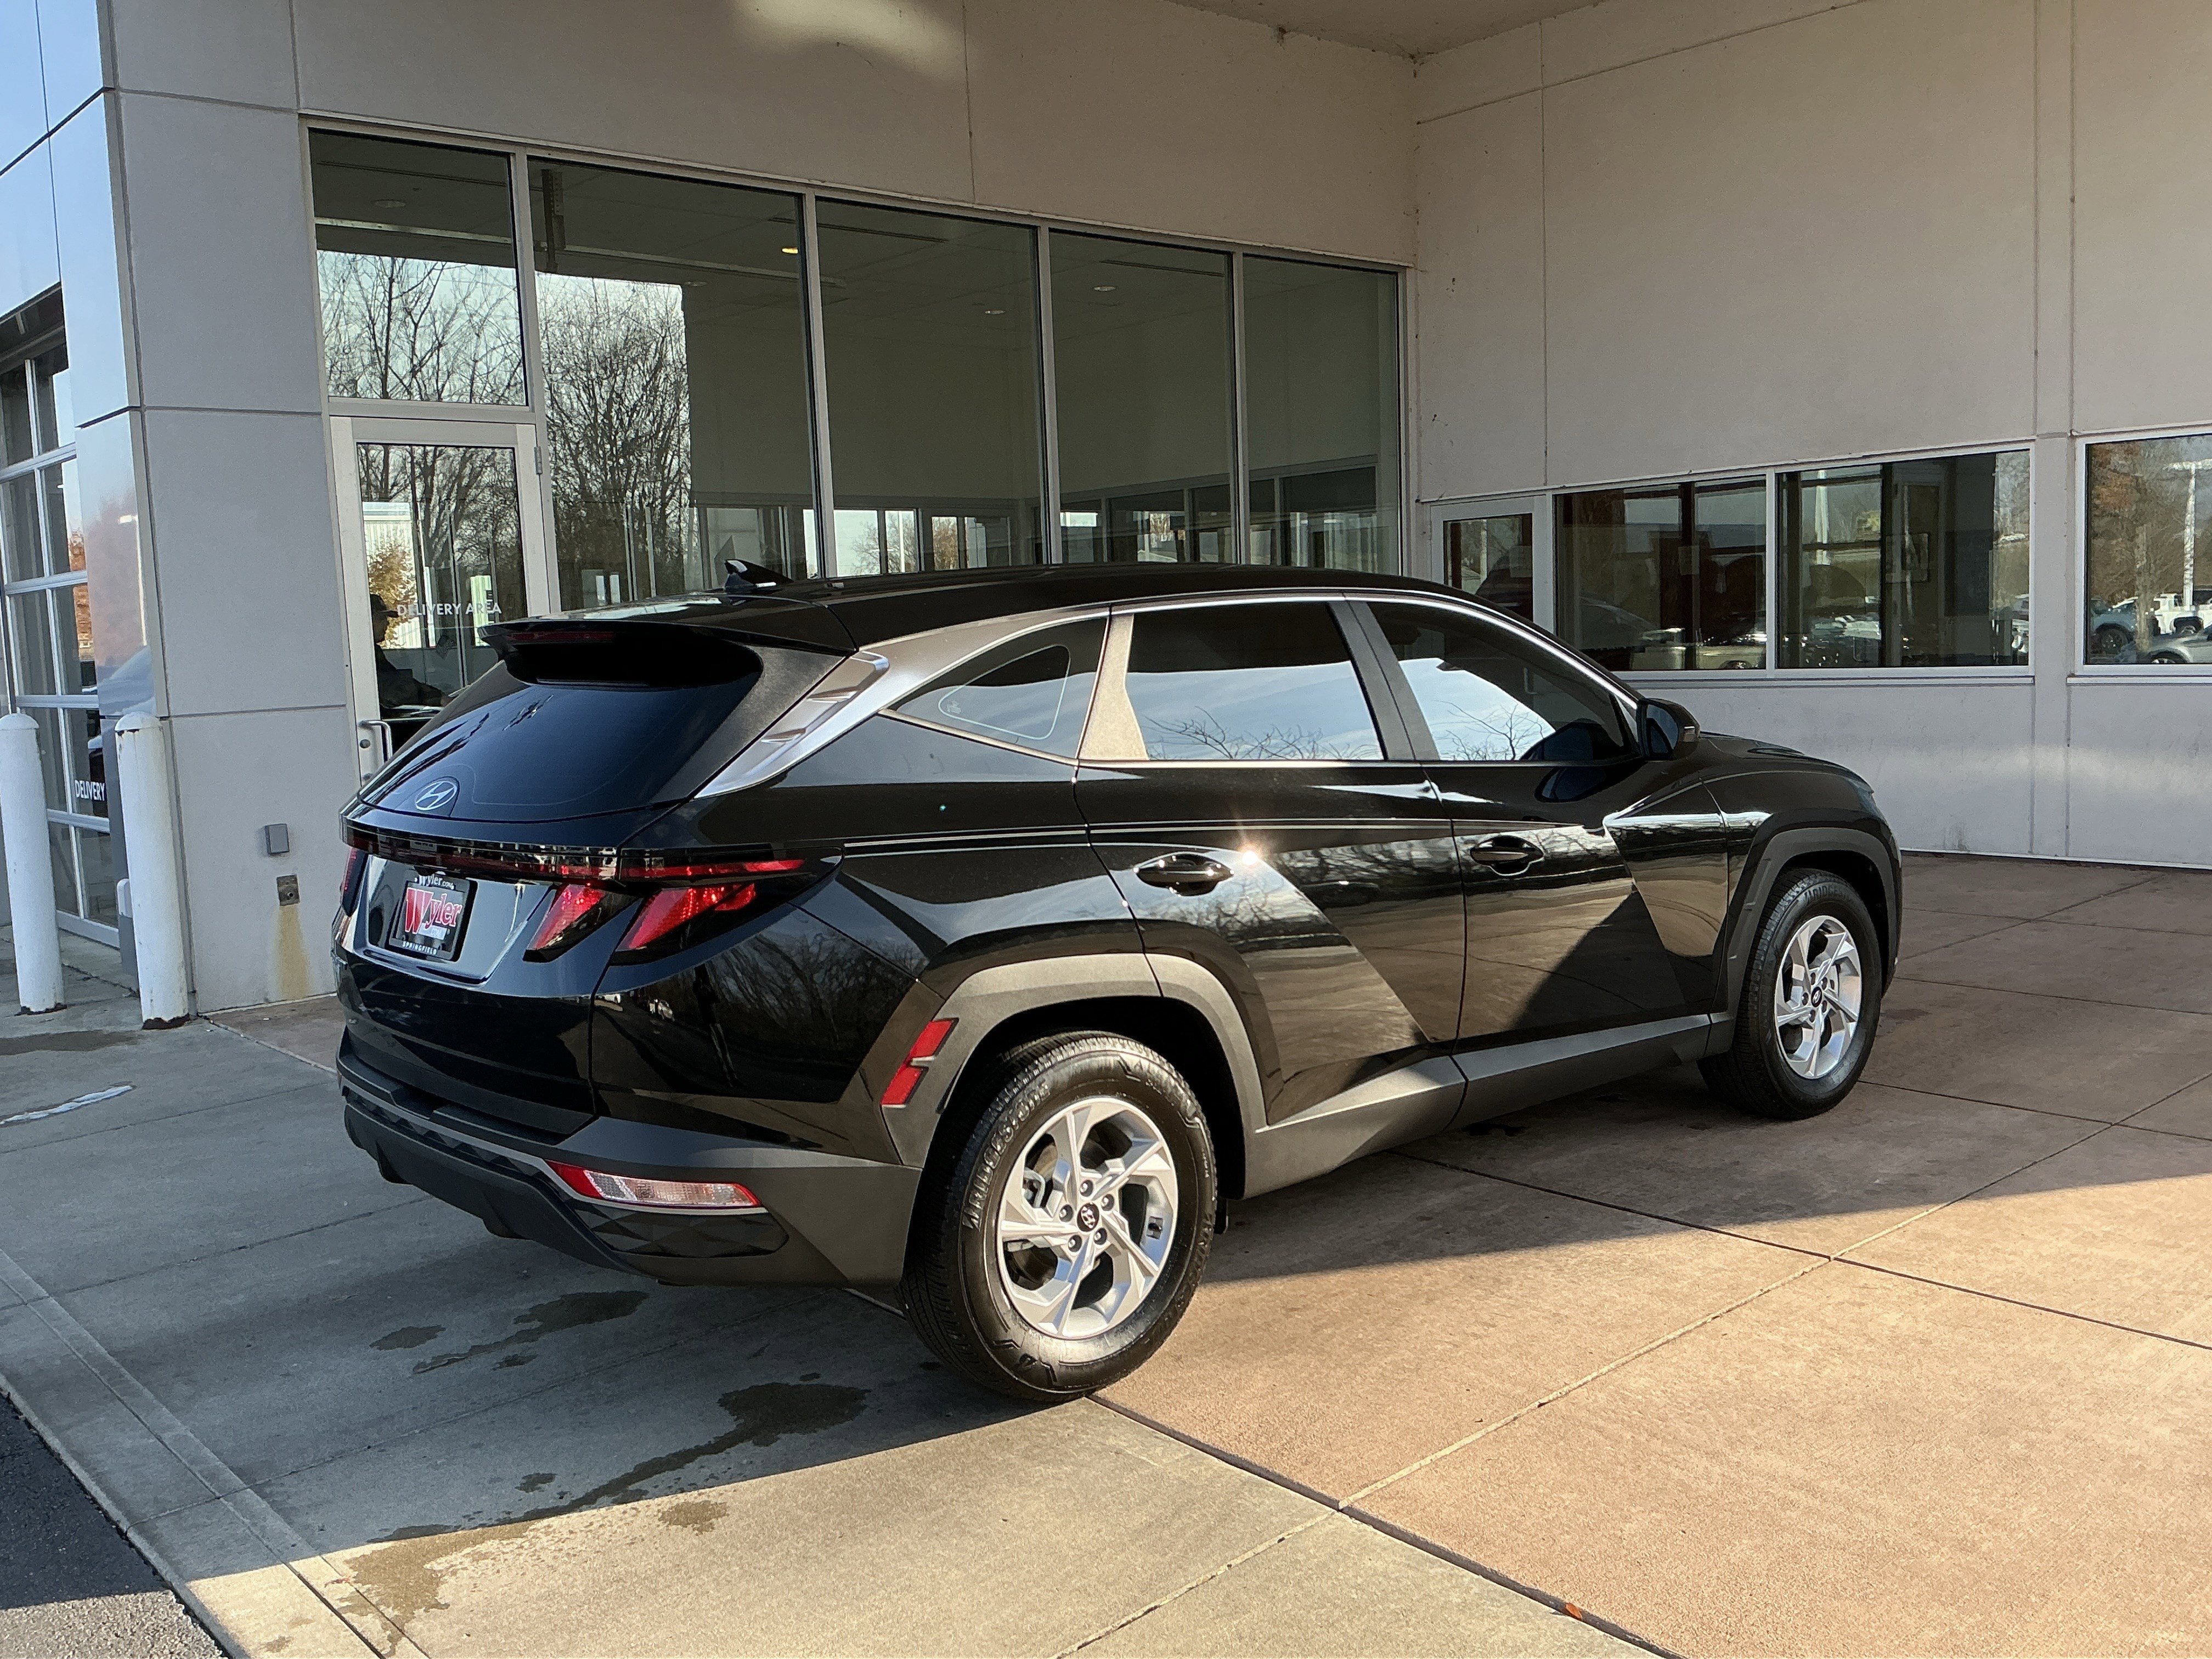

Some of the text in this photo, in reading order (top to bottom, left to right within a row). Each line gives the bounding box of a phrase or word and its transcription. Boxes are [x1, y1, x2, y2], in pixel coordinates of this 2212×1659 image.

[396, 602, 502, 616] DELIVERY AREA
[75, 780, 105, 802] DELIVERY
[405, 887, 463, 934] Wyler
[402, 940, 437, 955] SPRINGFIELD
